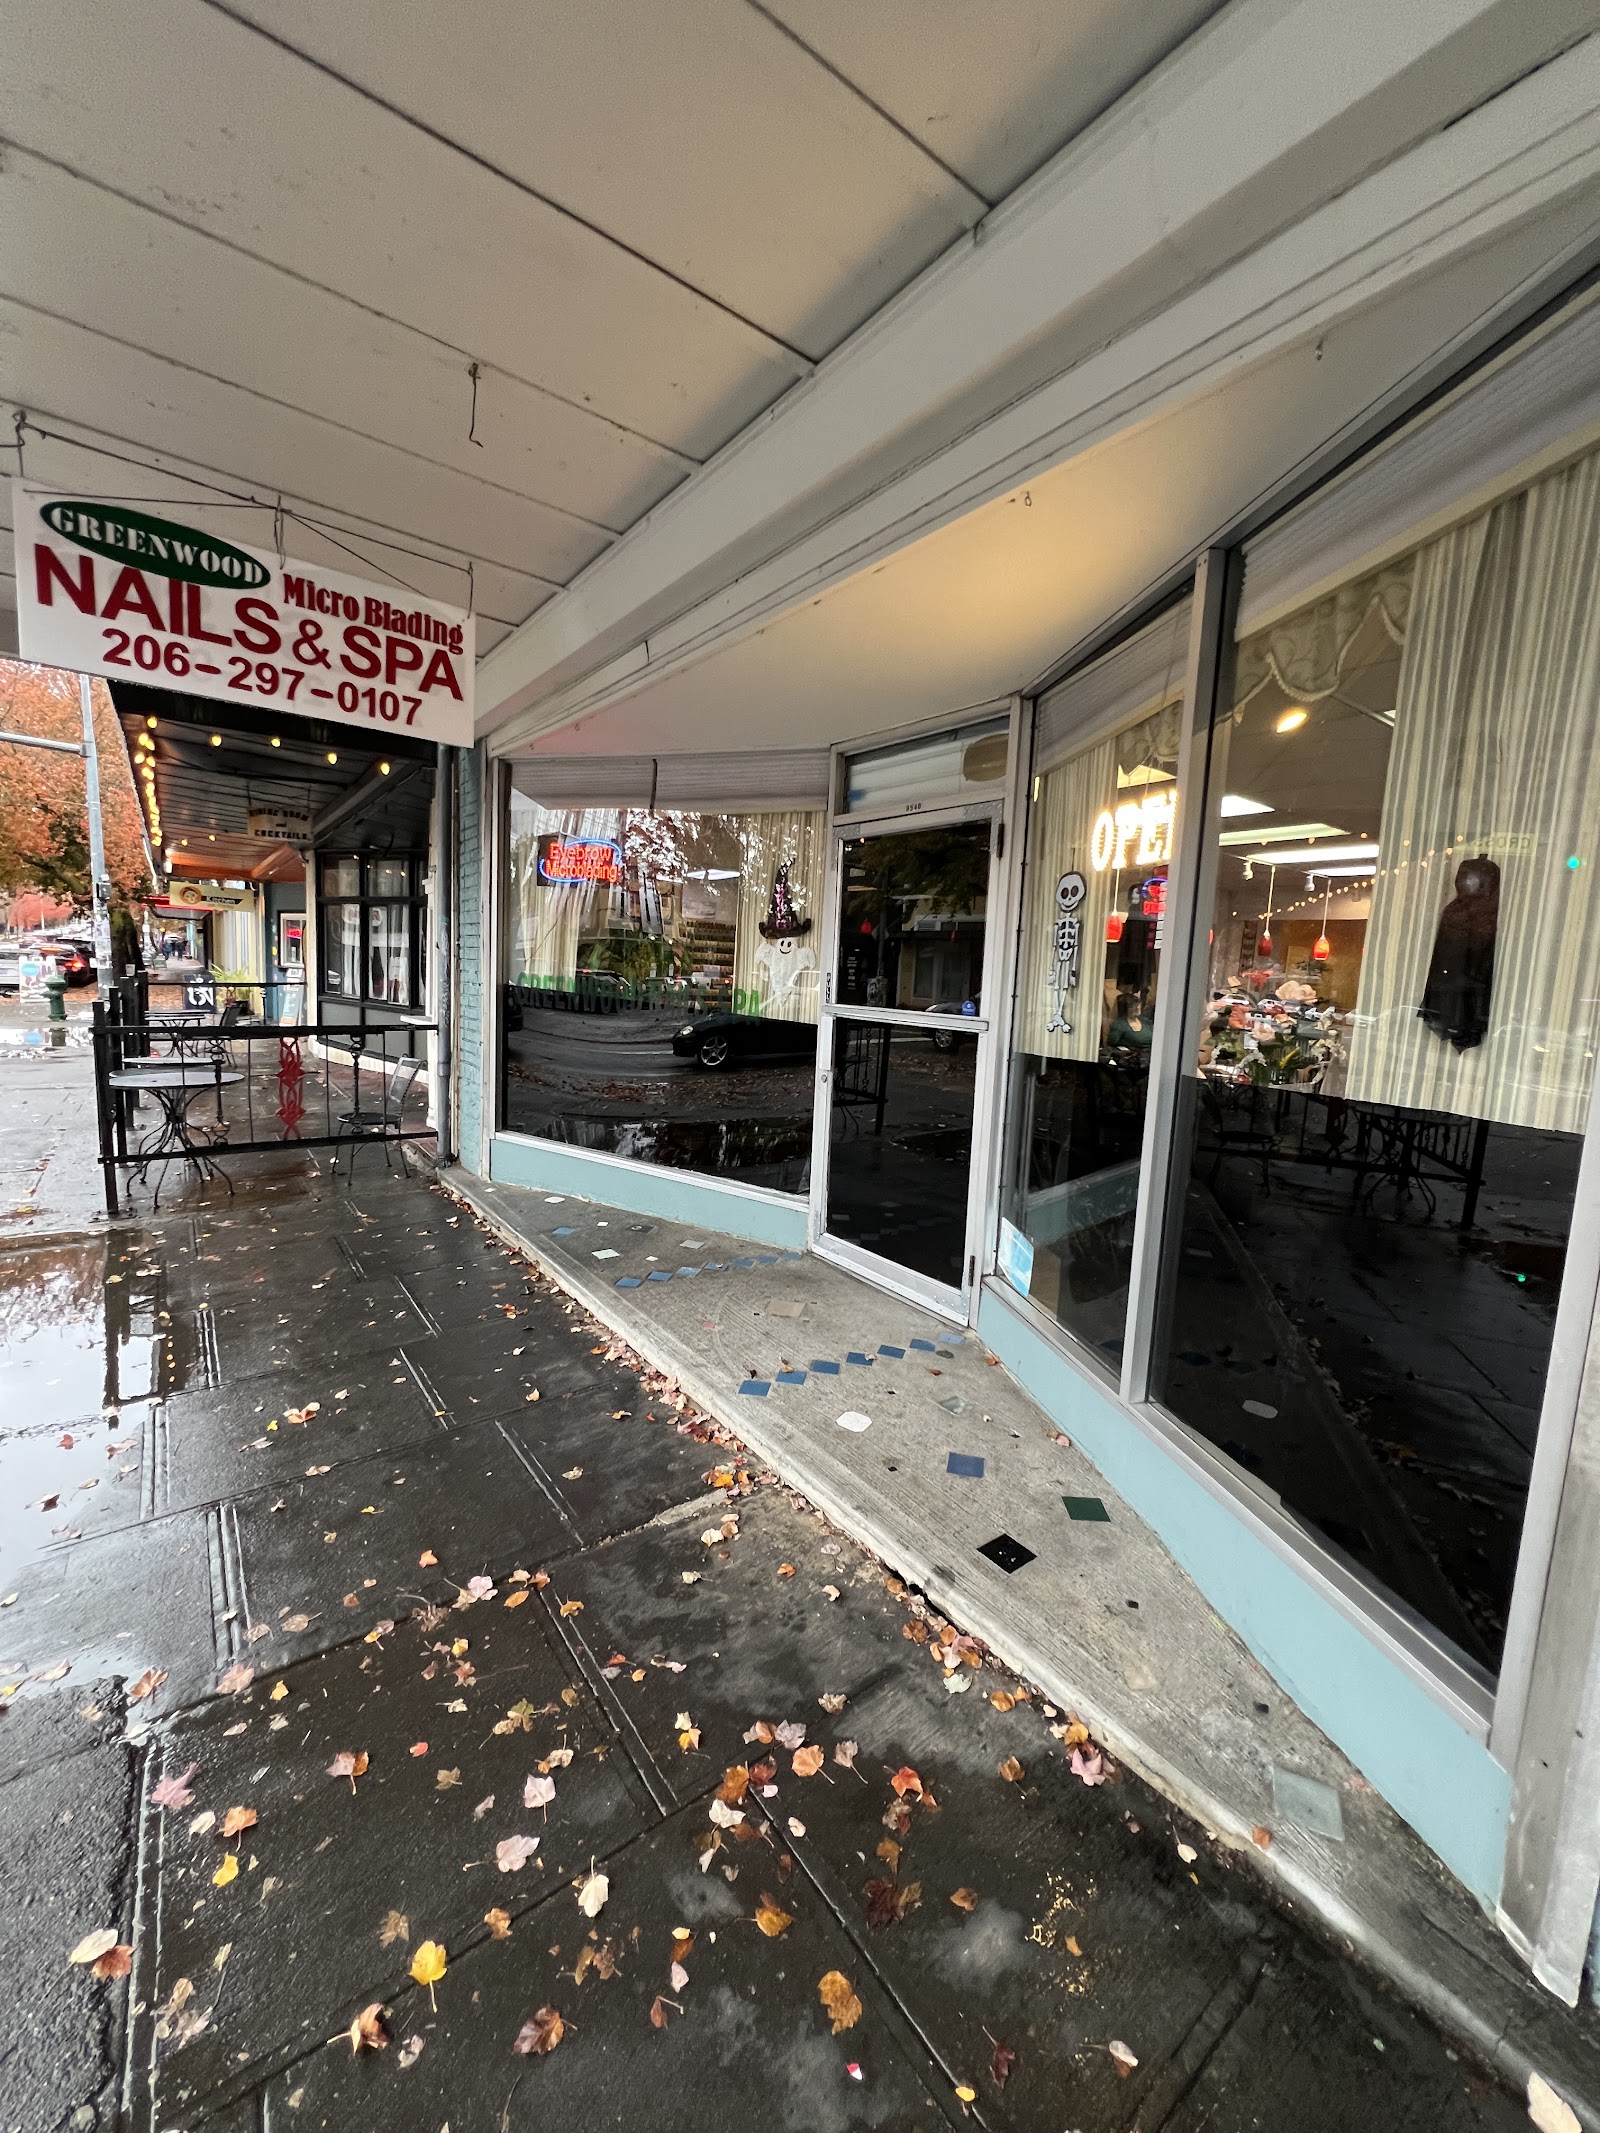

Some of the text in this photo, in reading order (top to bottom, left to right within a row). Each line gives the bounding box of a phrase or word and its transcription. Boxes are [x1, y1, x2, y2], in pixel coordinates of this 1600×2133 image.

[51, 507, 263, 584] GREENWOOD
[34, 543, 464, 701] NAILS & SPA
[283, 573, 464, 656] Micro Blading
[102, 628, 422, 726] 206-297-0107
[254, 829, 308, 840] COCKTAILS
[549, 841, 612, 862] Eyebrow
[545, 859, 618, 883] Microblading
[206, 895, 236, 905] Kitchen
[517, 971, 643, 1015] GREENWOOD
